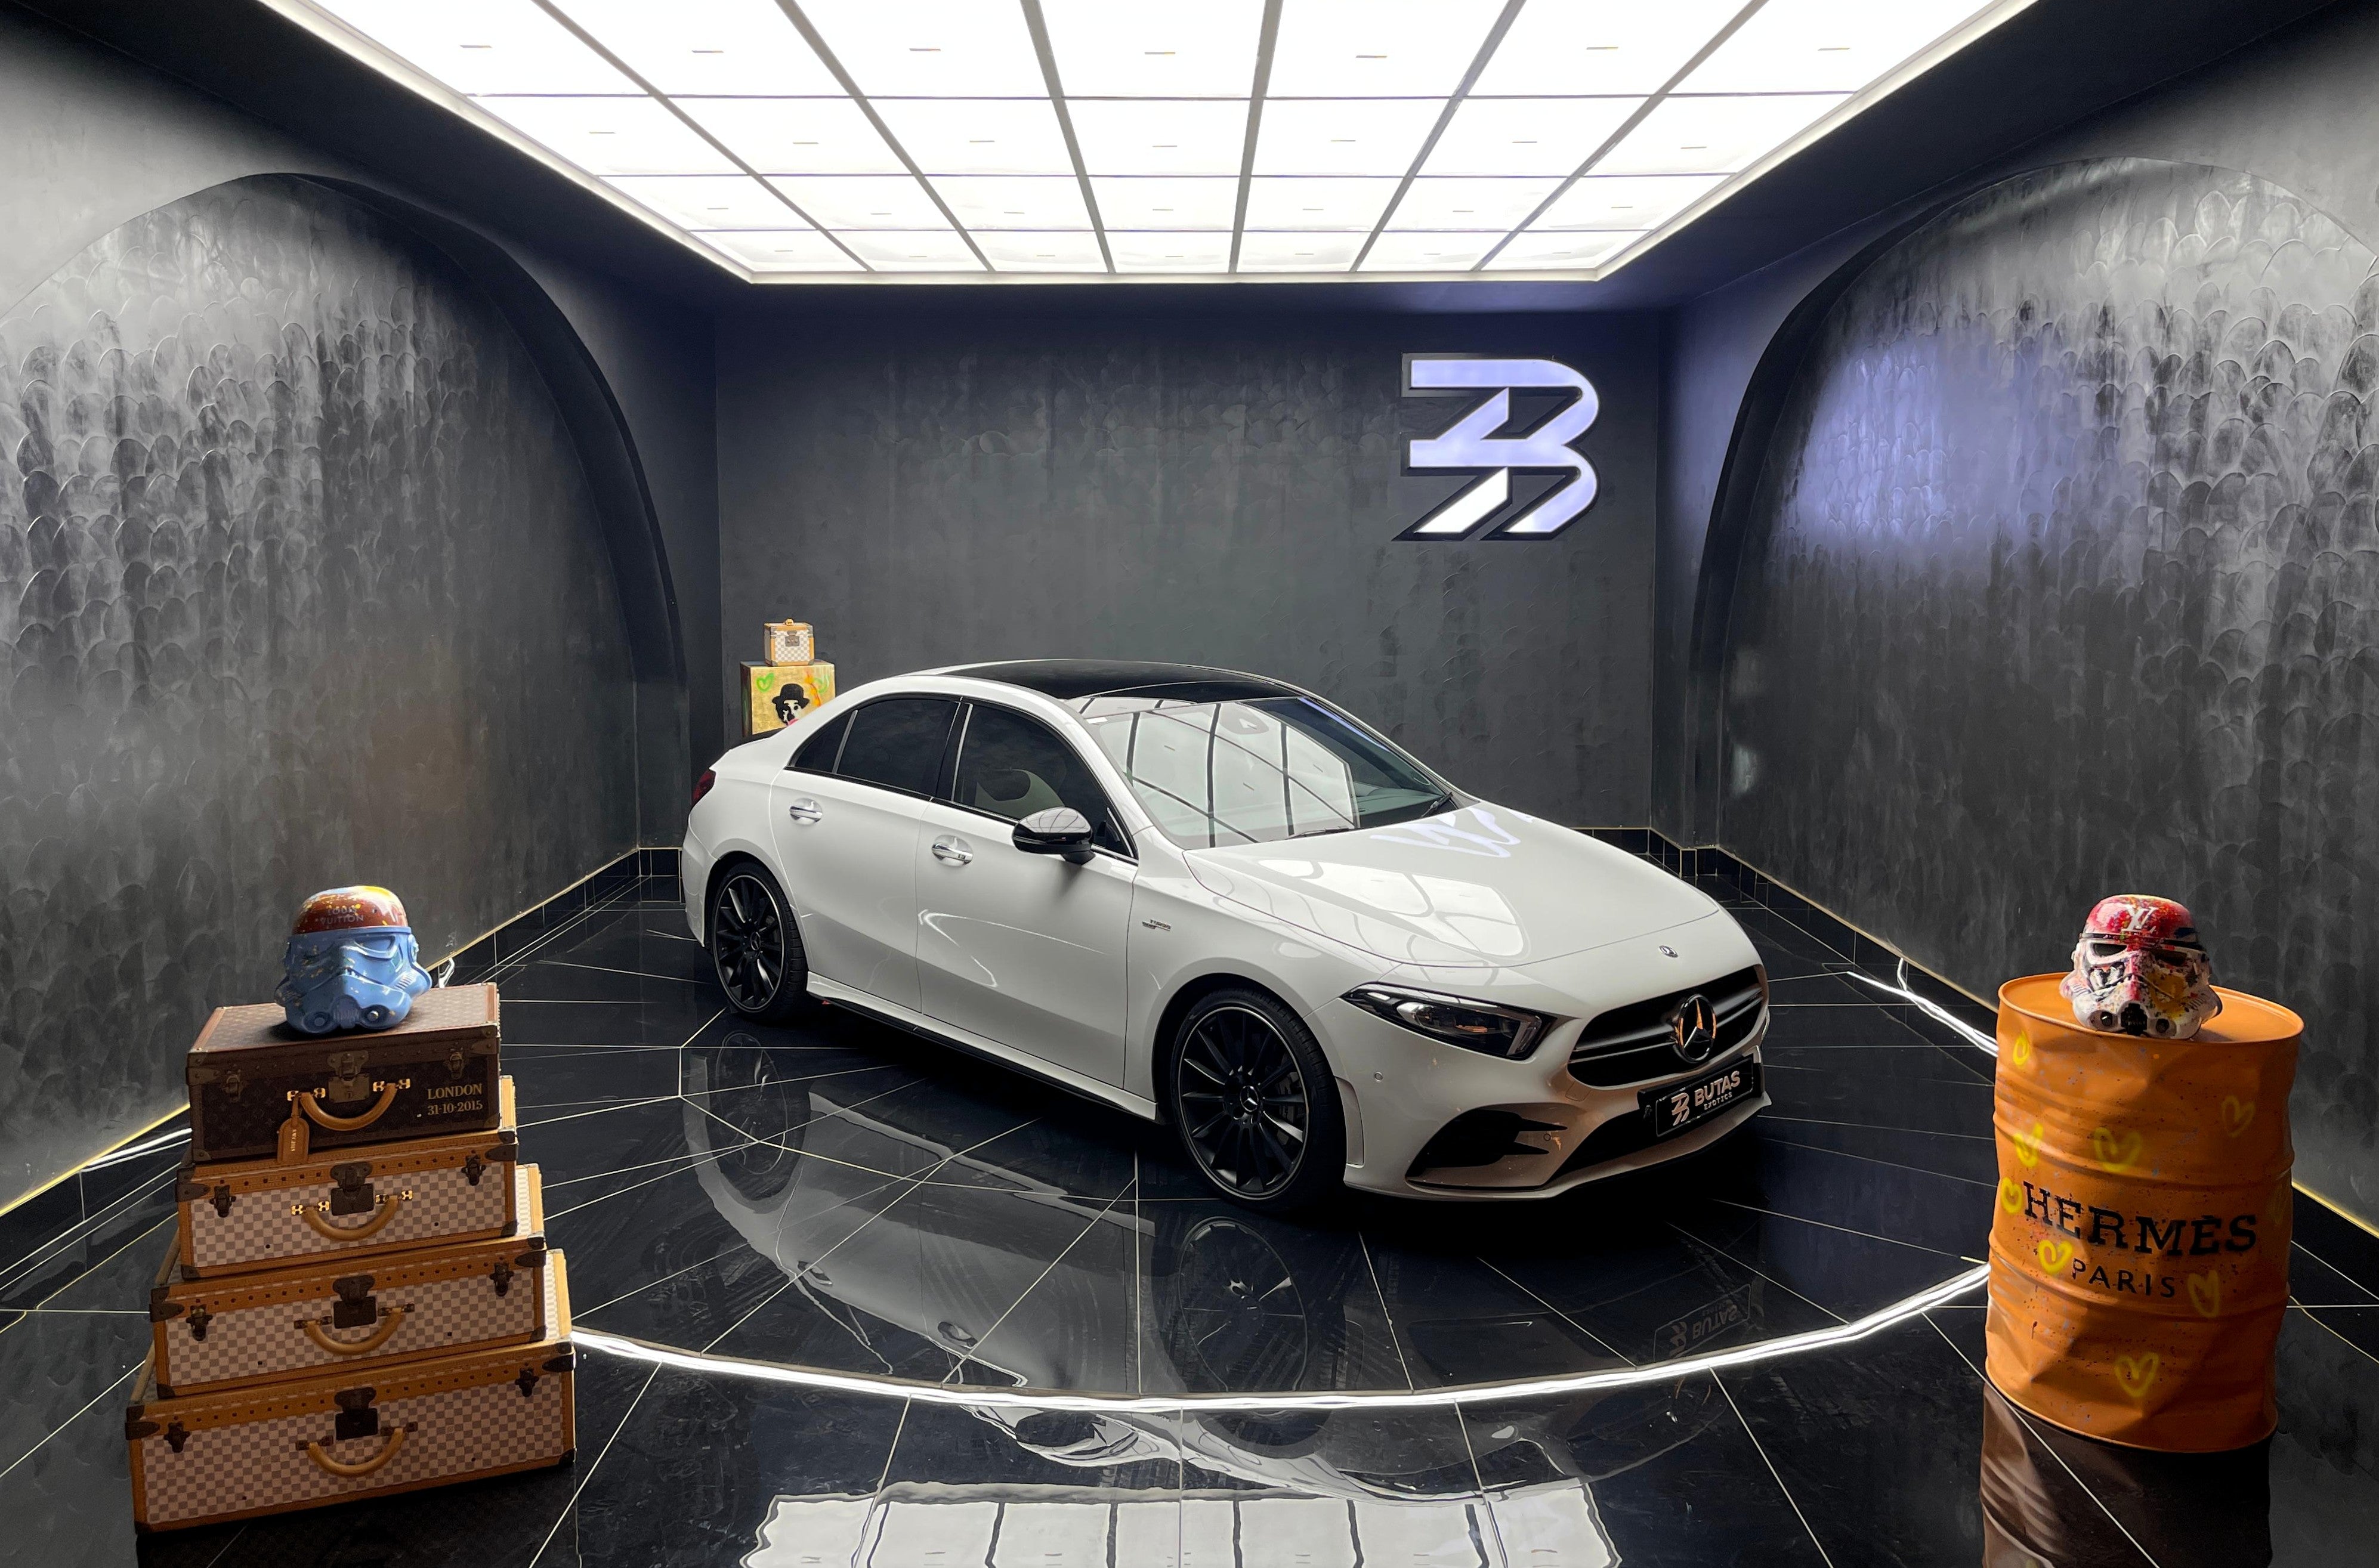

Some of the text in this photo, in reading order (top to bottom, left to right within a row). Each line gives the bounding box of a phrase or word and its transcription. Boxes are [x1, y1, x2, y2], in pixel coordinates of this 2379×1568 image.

[320, 914, 364, 925] VUITTON
[427, 1083, 483, 1100] LONDON
[1694, 1071, 1741, 1107] BUTAS
[428, 1100, 483, 1116] 31-10-2015
[1704, 1091, 1733, 1111] EXOTICS
[2072, 1258, 2176, 1298] PARIS
